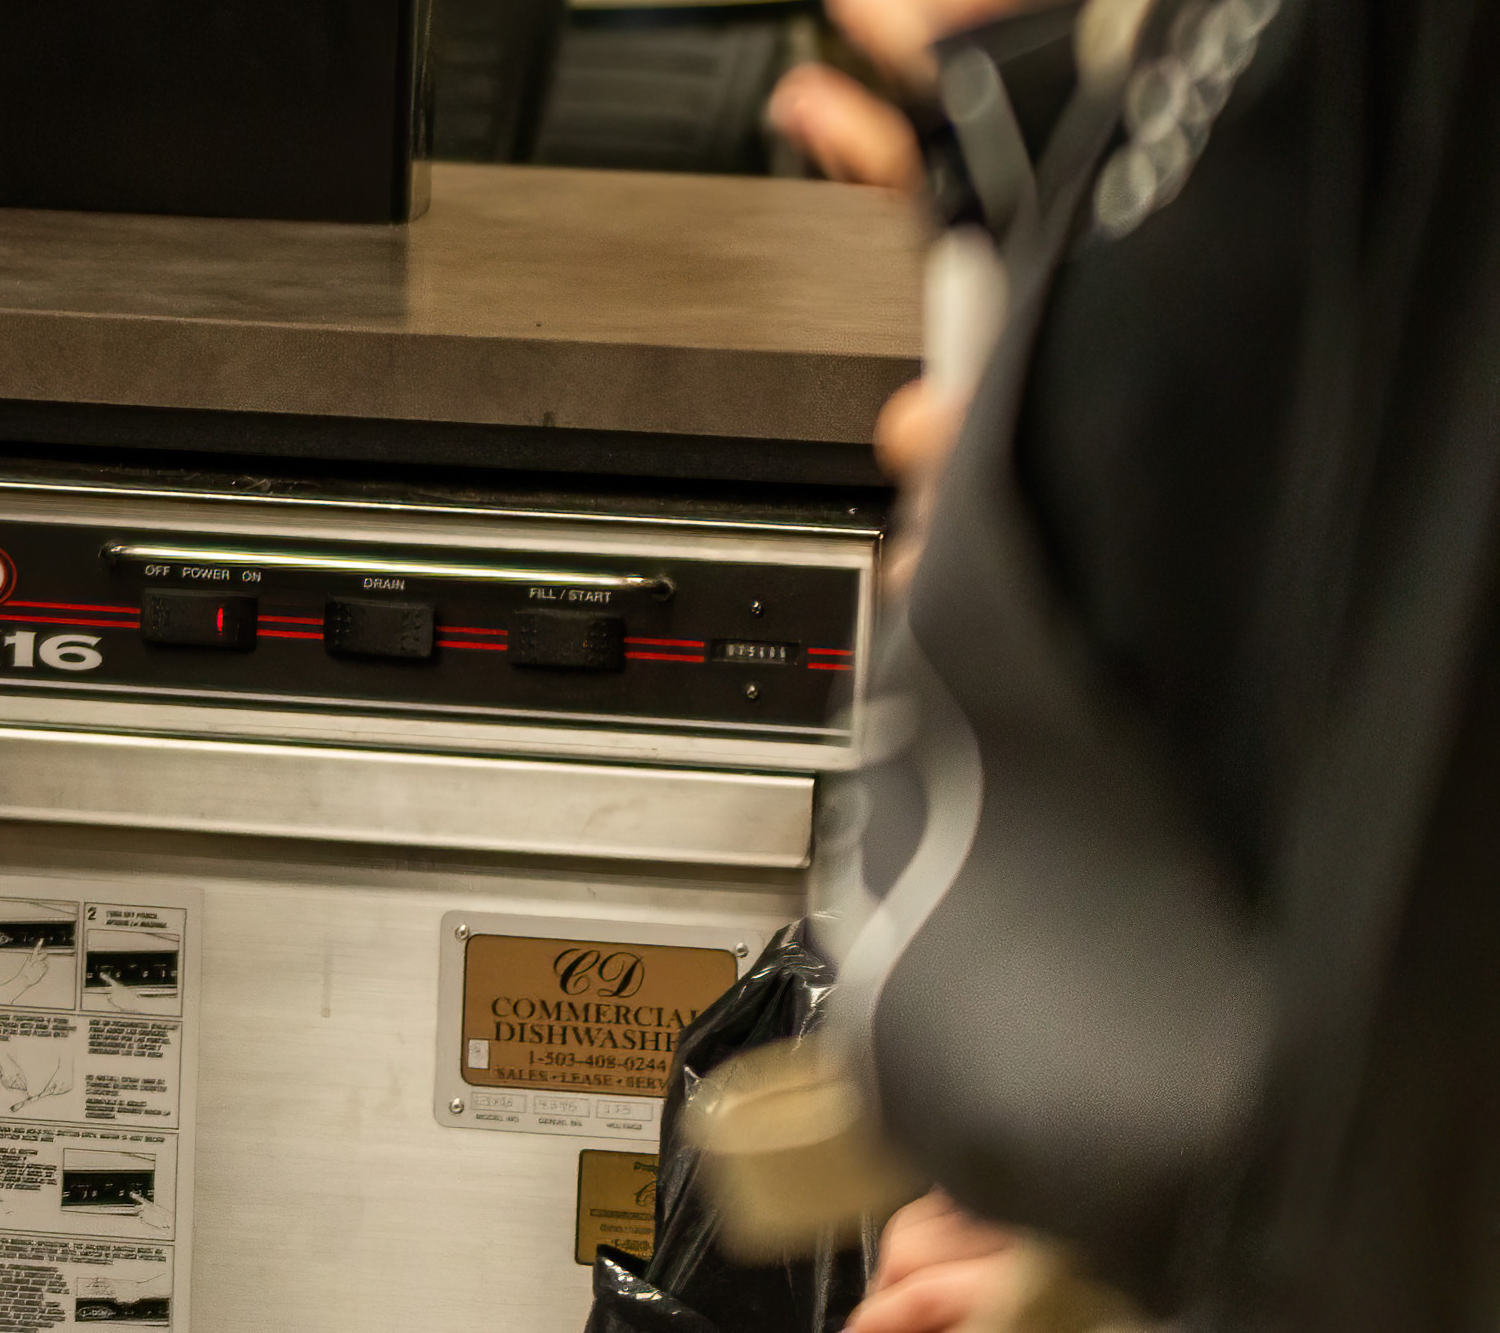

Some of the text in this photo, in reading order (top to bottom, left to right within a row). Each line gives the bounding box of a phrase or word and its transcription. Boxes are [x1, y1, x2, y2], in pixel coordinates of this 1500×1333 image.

[144, 564, 262, 583] OFF POWER ON
[363, 577, 405, 591] DRAIN
[528, 587, 556, 600] FILL
[568, 590, 612, 604] START
[553, 947, 645, 999] CD
[528, 1050, 667, 1073] 1-503-408-0244
[495, 1067, 548, 1083] SALES
[559, 1071, 614, 1086] LEASE
